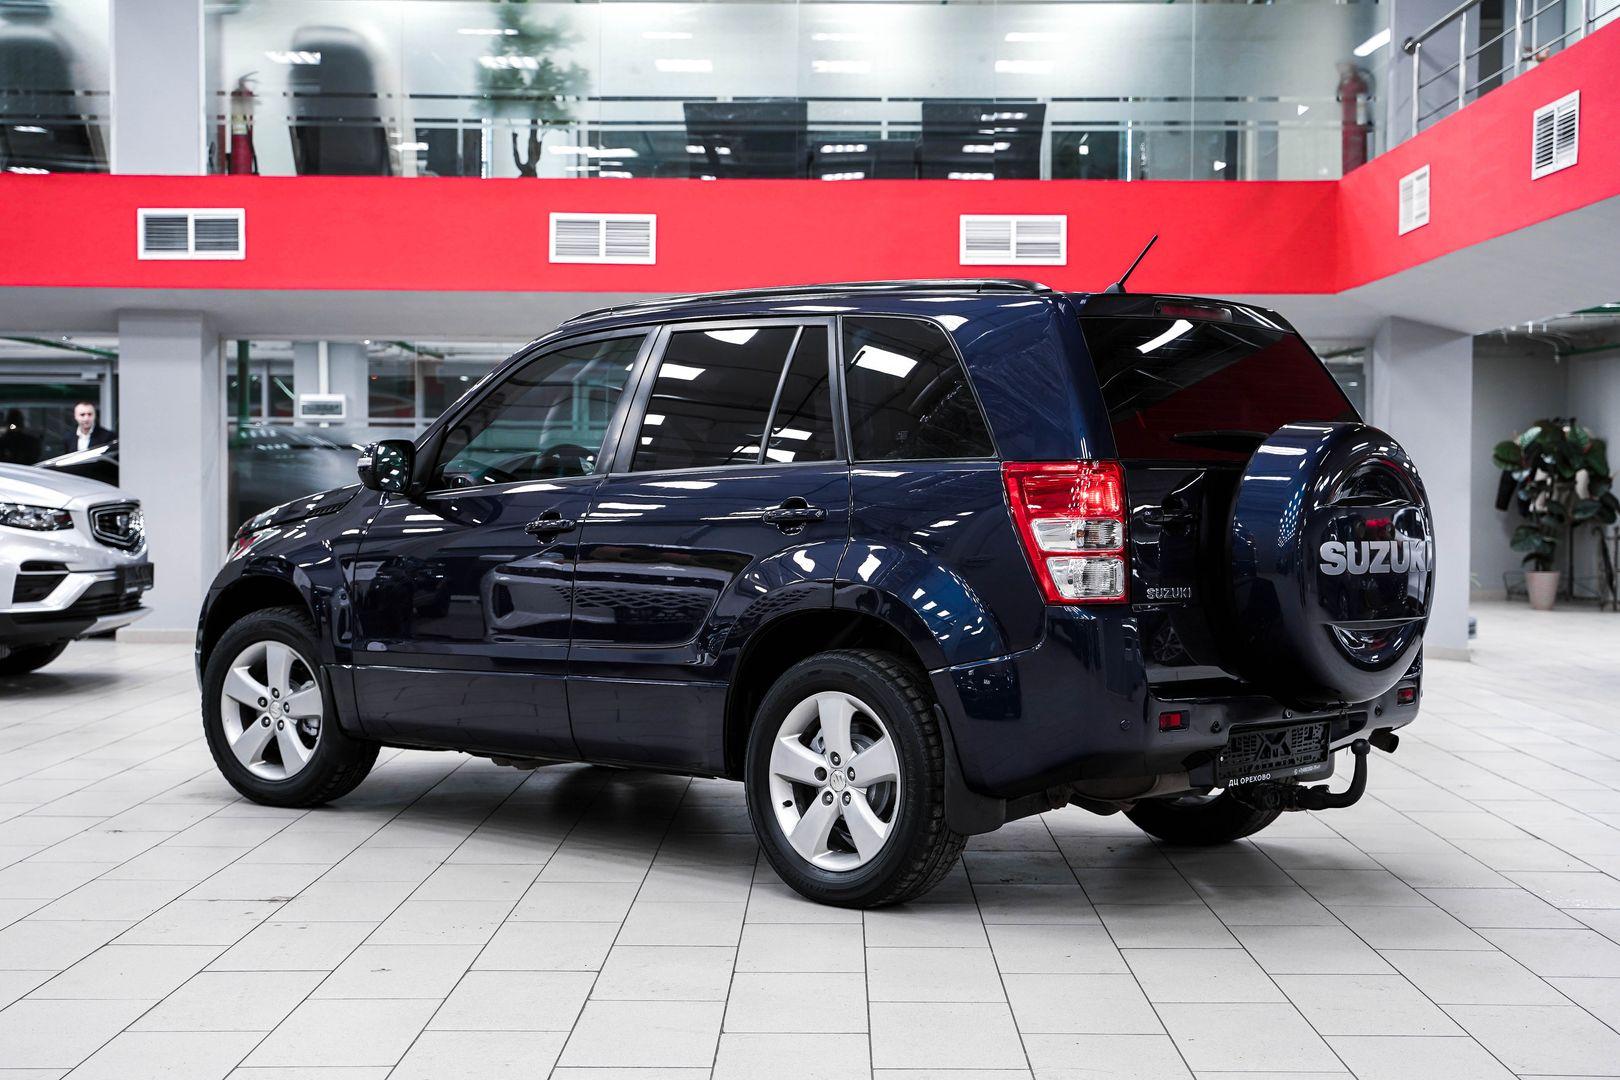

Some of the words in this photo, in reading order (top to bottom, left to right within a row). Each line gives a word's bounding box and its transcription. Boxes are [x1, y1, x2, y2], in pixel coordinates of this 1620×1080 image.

[1320, 540, 1433, 575] SUZUKI
[1146, 587, 1191, 599] SUZUKI
[1228, 779, 1239, 787] ДЦ
[1240, 773, 1271, 784] ОРЕХОВО
